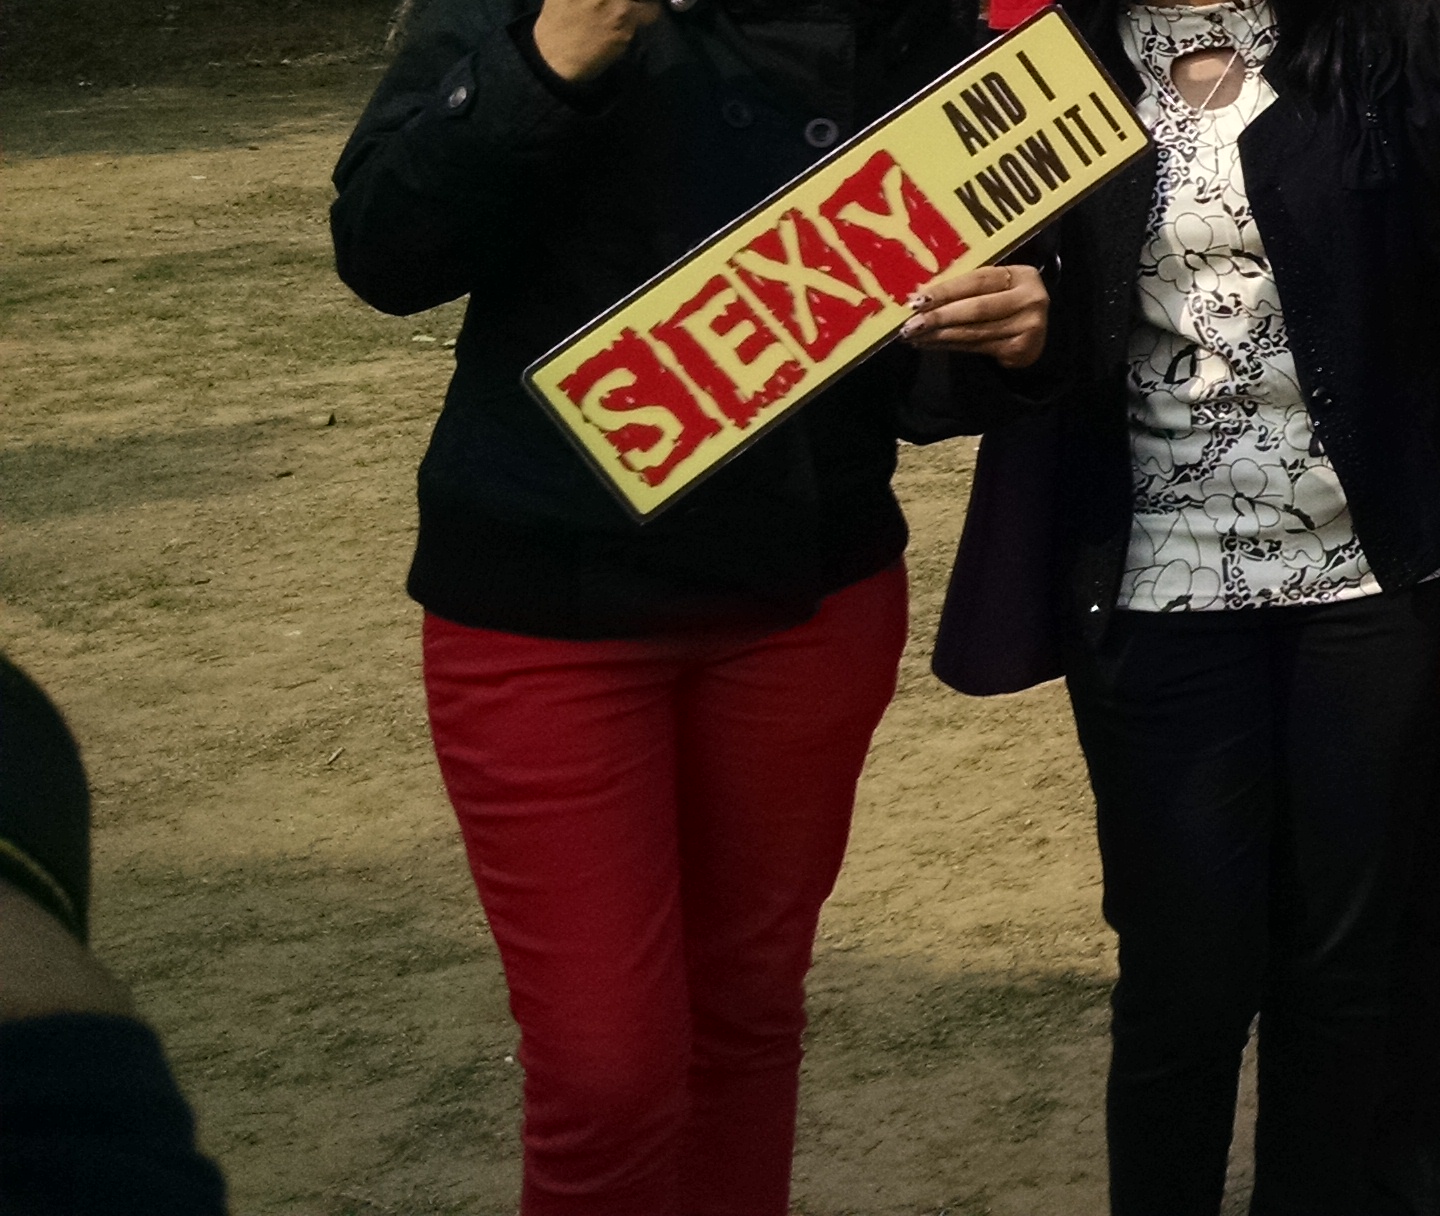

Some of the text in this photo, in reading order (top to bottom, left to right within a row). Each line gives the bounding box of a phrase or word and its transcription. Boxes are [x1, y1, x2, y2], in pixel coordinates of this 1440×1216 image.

[941, 49, 1057, 158] AND I
[952, 128, 1072, 239] KNOW
[574, 159, 946, 475] SEXY
